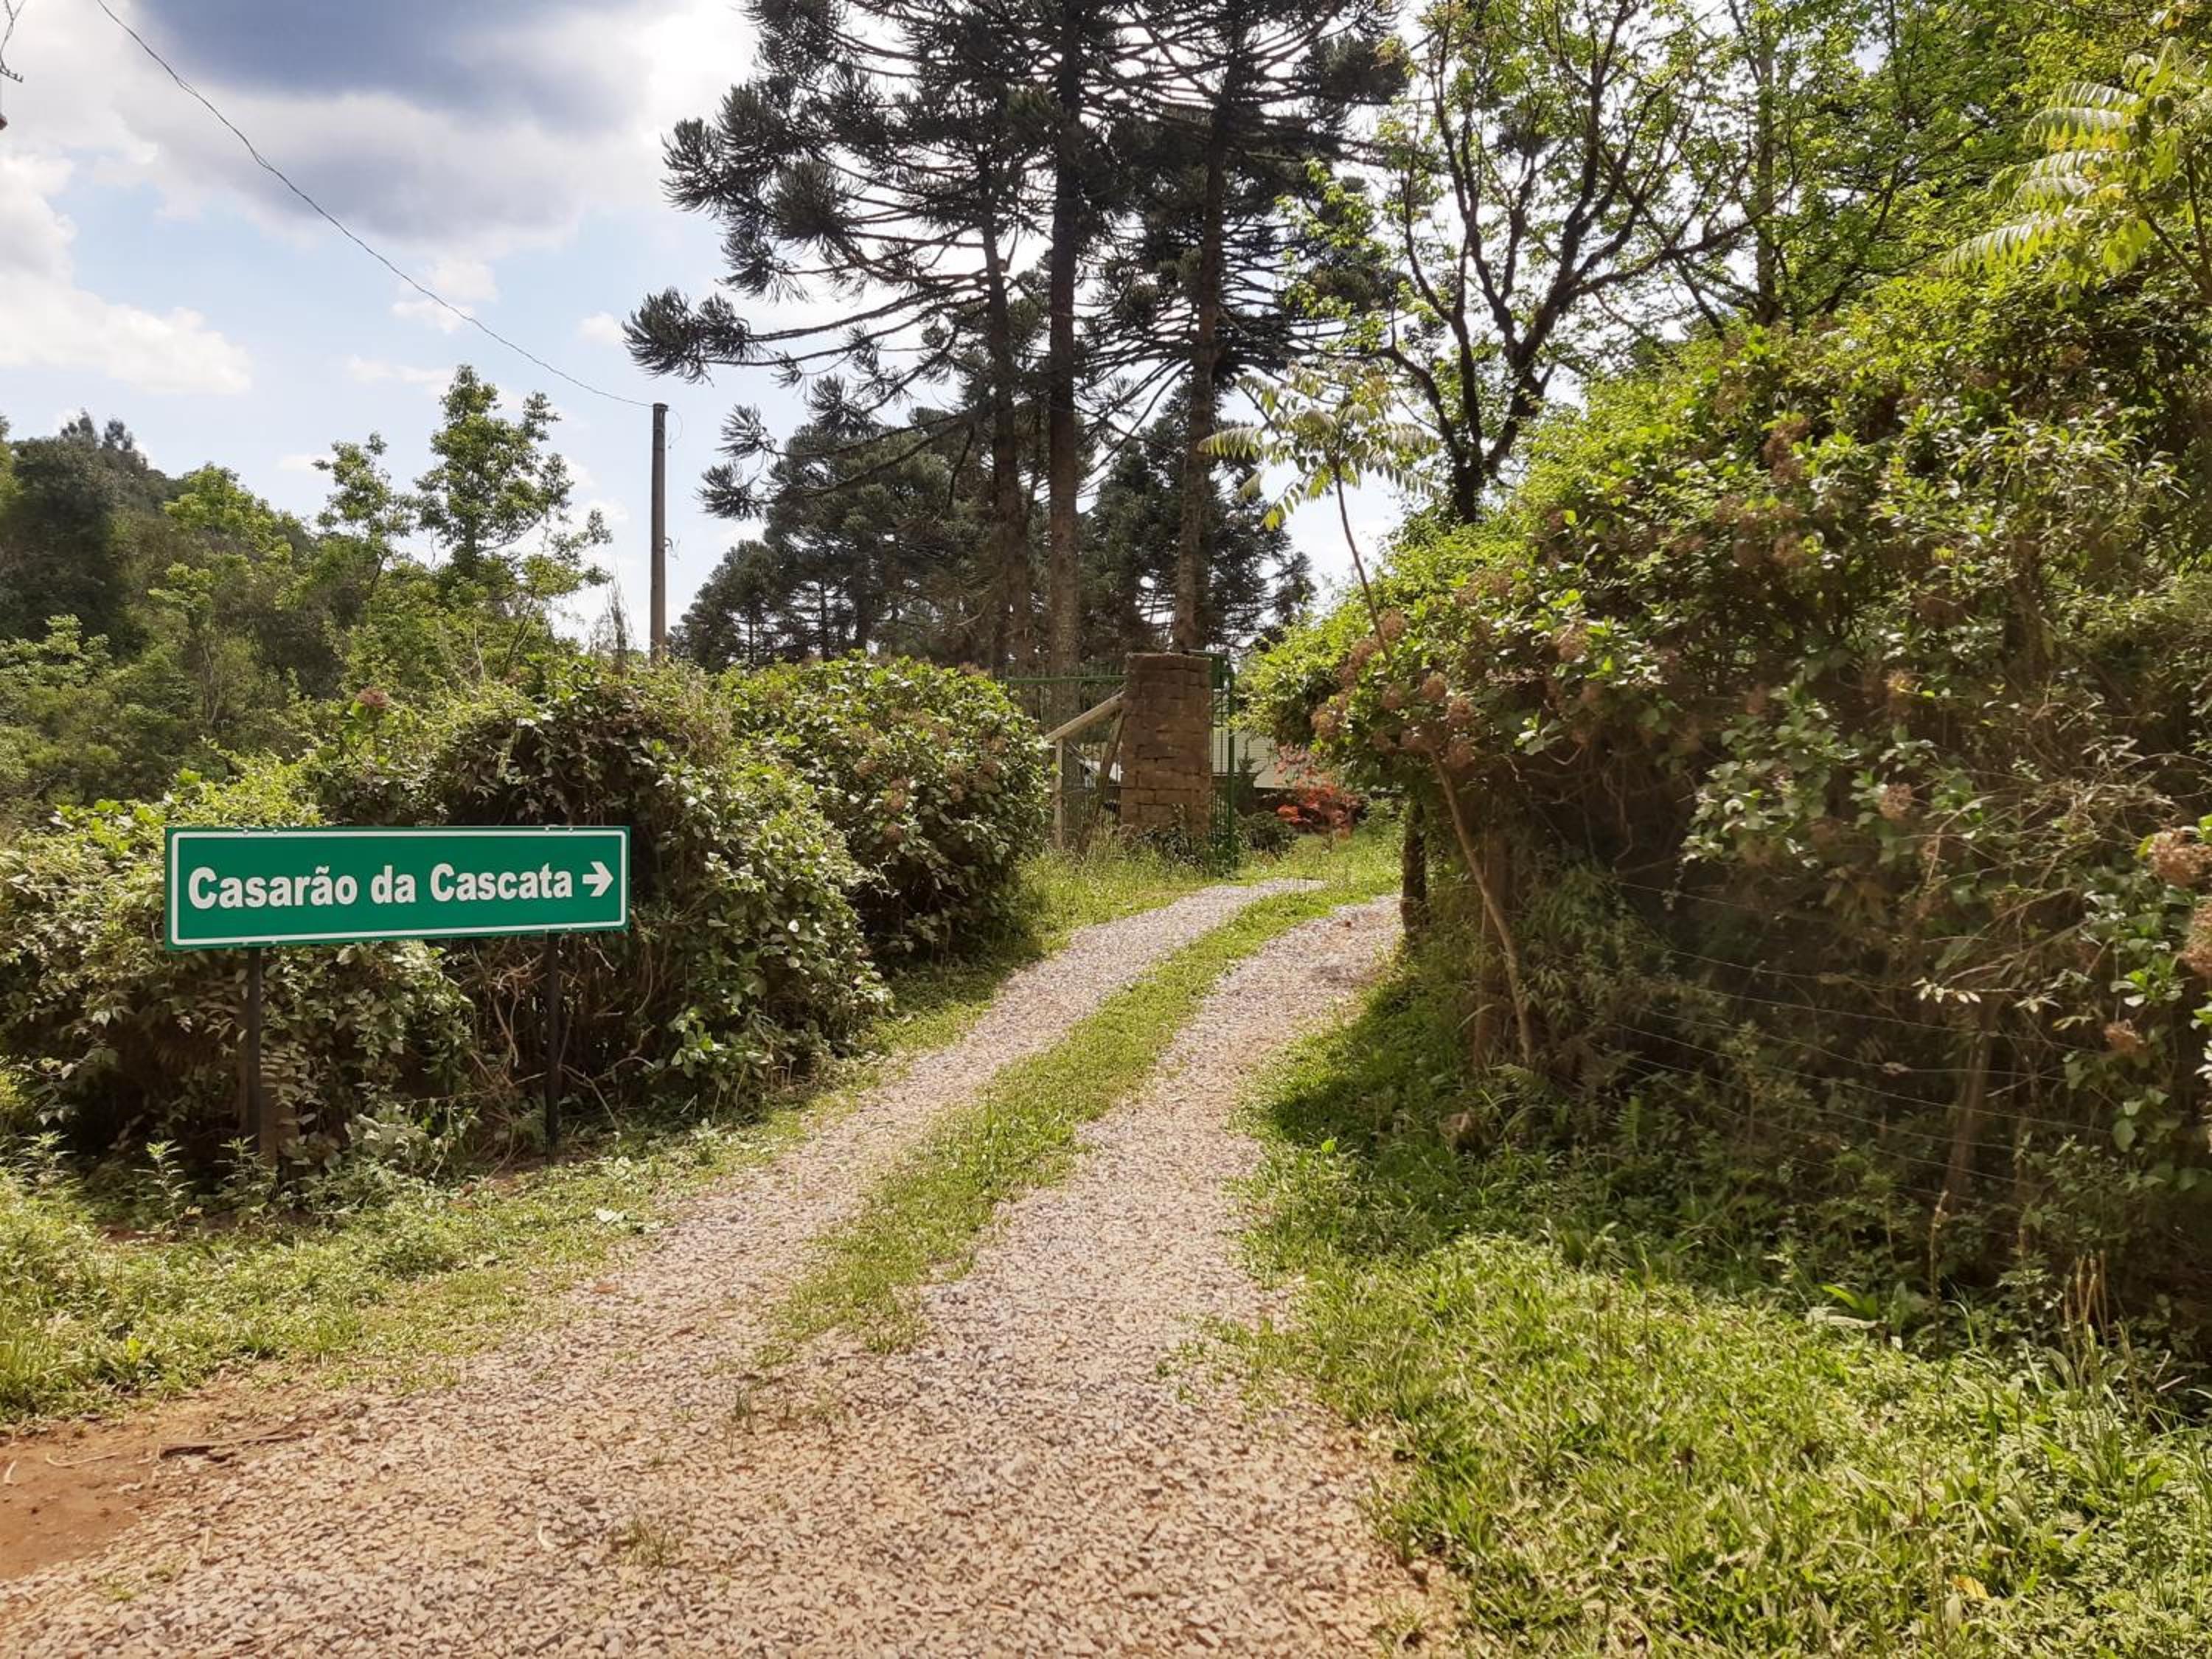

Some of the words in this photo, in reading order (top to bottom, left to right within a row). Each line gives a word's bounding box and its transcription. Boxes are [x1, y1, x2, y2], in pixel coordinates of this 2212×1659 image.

[188, 866, 358, 909] Casarão
[371, 865, 416, 904] da
[430, 863, 573, 902] Cascata
